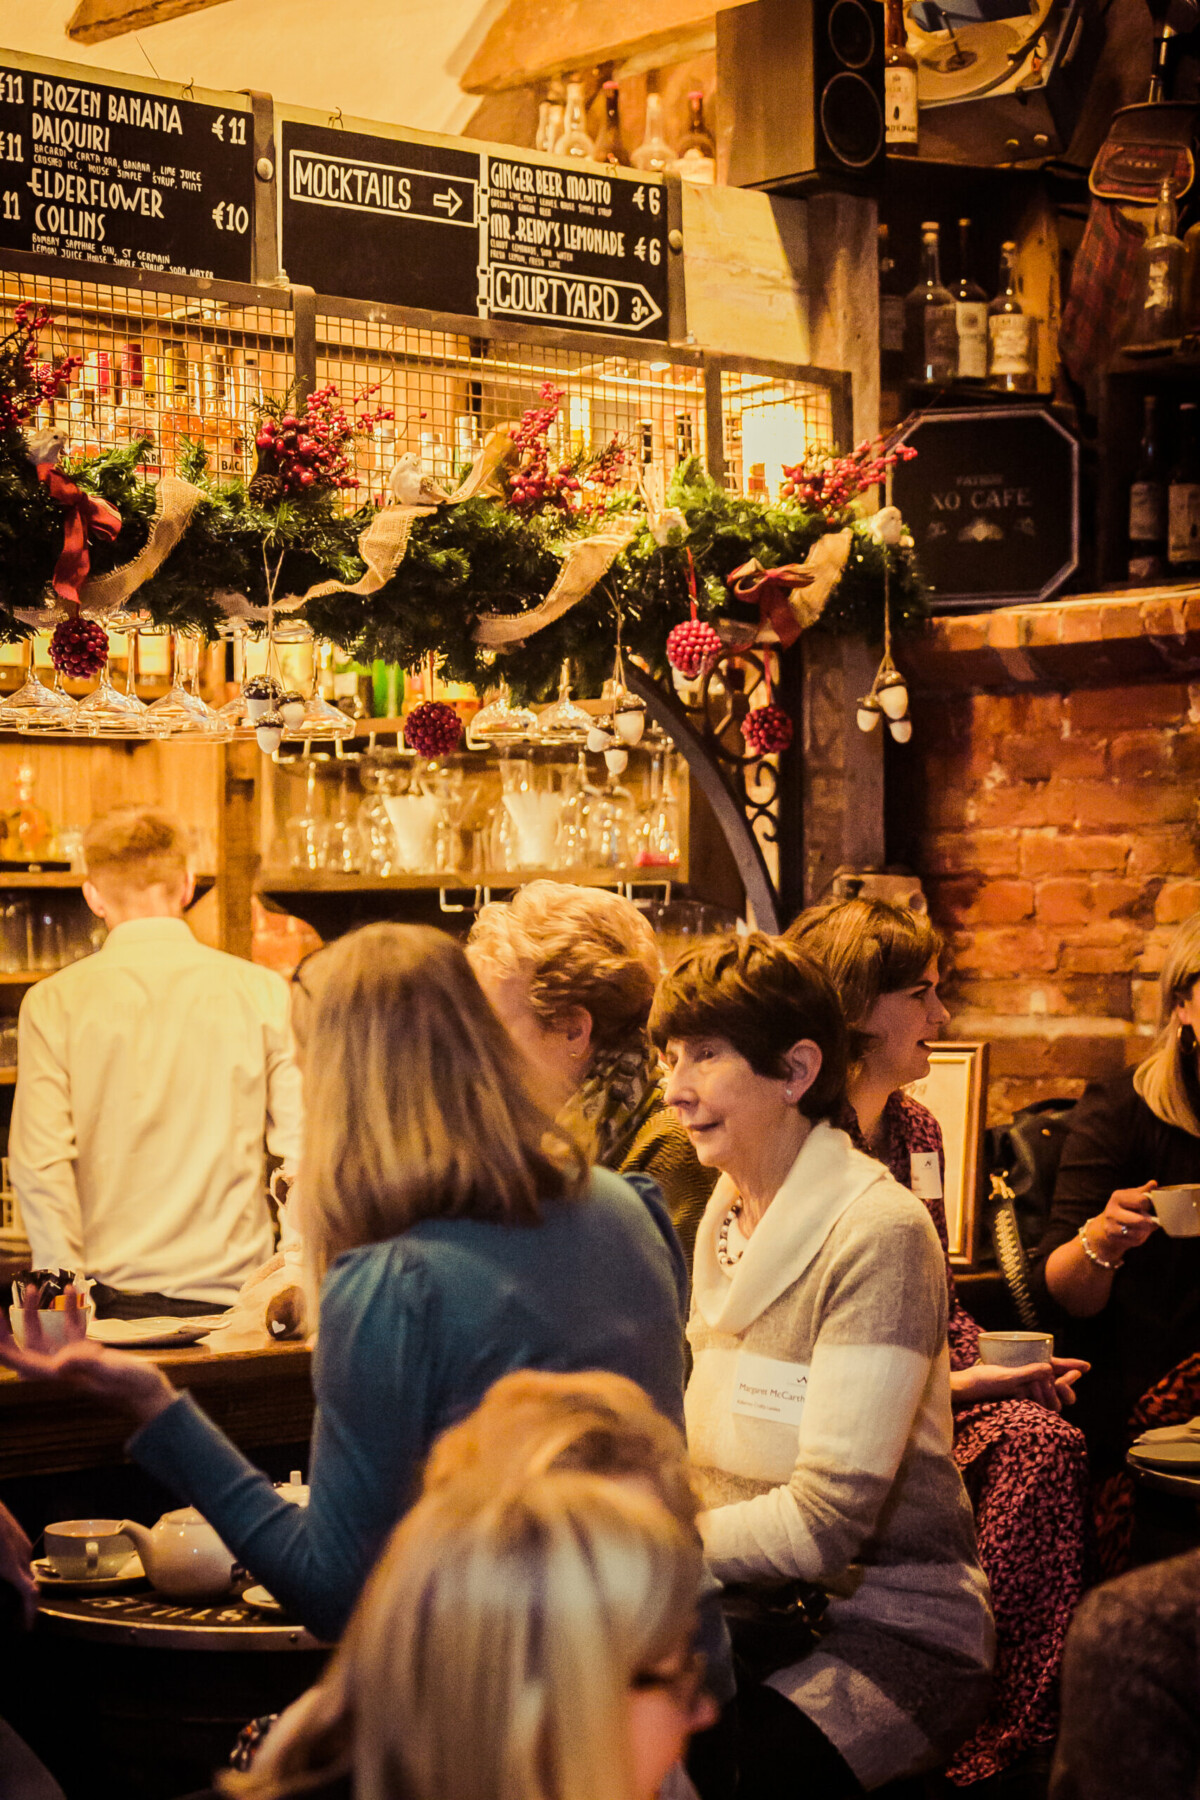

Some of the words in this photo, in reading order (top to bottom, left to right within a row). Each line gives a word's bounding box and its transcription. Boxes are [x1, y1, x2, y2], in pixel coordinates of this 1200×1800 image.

[33, 78, 101, 119] FROZEN
[108, 94, 183, 135] BANANA
[32, 112, 110, 153] DAIQUIRI
[211, 114, 247, 145] €11
[34, 143, 67, 158] BACARDI
[76, 151, 100, 163] CARTA
[160, 165, 176, 177] LIME
[180, 168, 201, 182] JUICE
[34, 154, 62, 168] CRUSHED
[88, 163, 110, 176] HOUSE
[117, 168, 142, 182] SIMPLE
[152, 175, 178, 189] SYRUP,
[181, 180, 202, 192] MINT
[26, 167, 165, 218] ELDERFLOWER
[295, 159, 412, 211] MOCKTAILS
[490, 162, 535, 193] GINGER
[535, 168, 565, 198] BEER
[566, 175, 612, 205] MOJITO
[35, 203, 106, 242] COLLINS
[211, 200, 249, 234] €10
[490, 213, 516, 241] MR.
[515, 216, 561, 247] REIDY'S
[563, 223, 626, 258] LEMONADE
[32, 232, 59, 247] BOMBAY
[65, 238, 96, 253] SAPPHIRE
[101, 245, 117, 258] GIN,
[121, 248, 132, 258] ST
[137, 251, 170, 264] GERMAIN
[32, 243, 57, 256] LEMON
[61, 248, 82, 260] JUICE
[87, 252, 107, 264] HOUSE
[113, 258, 136, 268] SIMPLE
[189, 268, 214, 279] WATER
[495, 270, 620, 322] COURTYARD
[931, 490, 961, 511] XO
